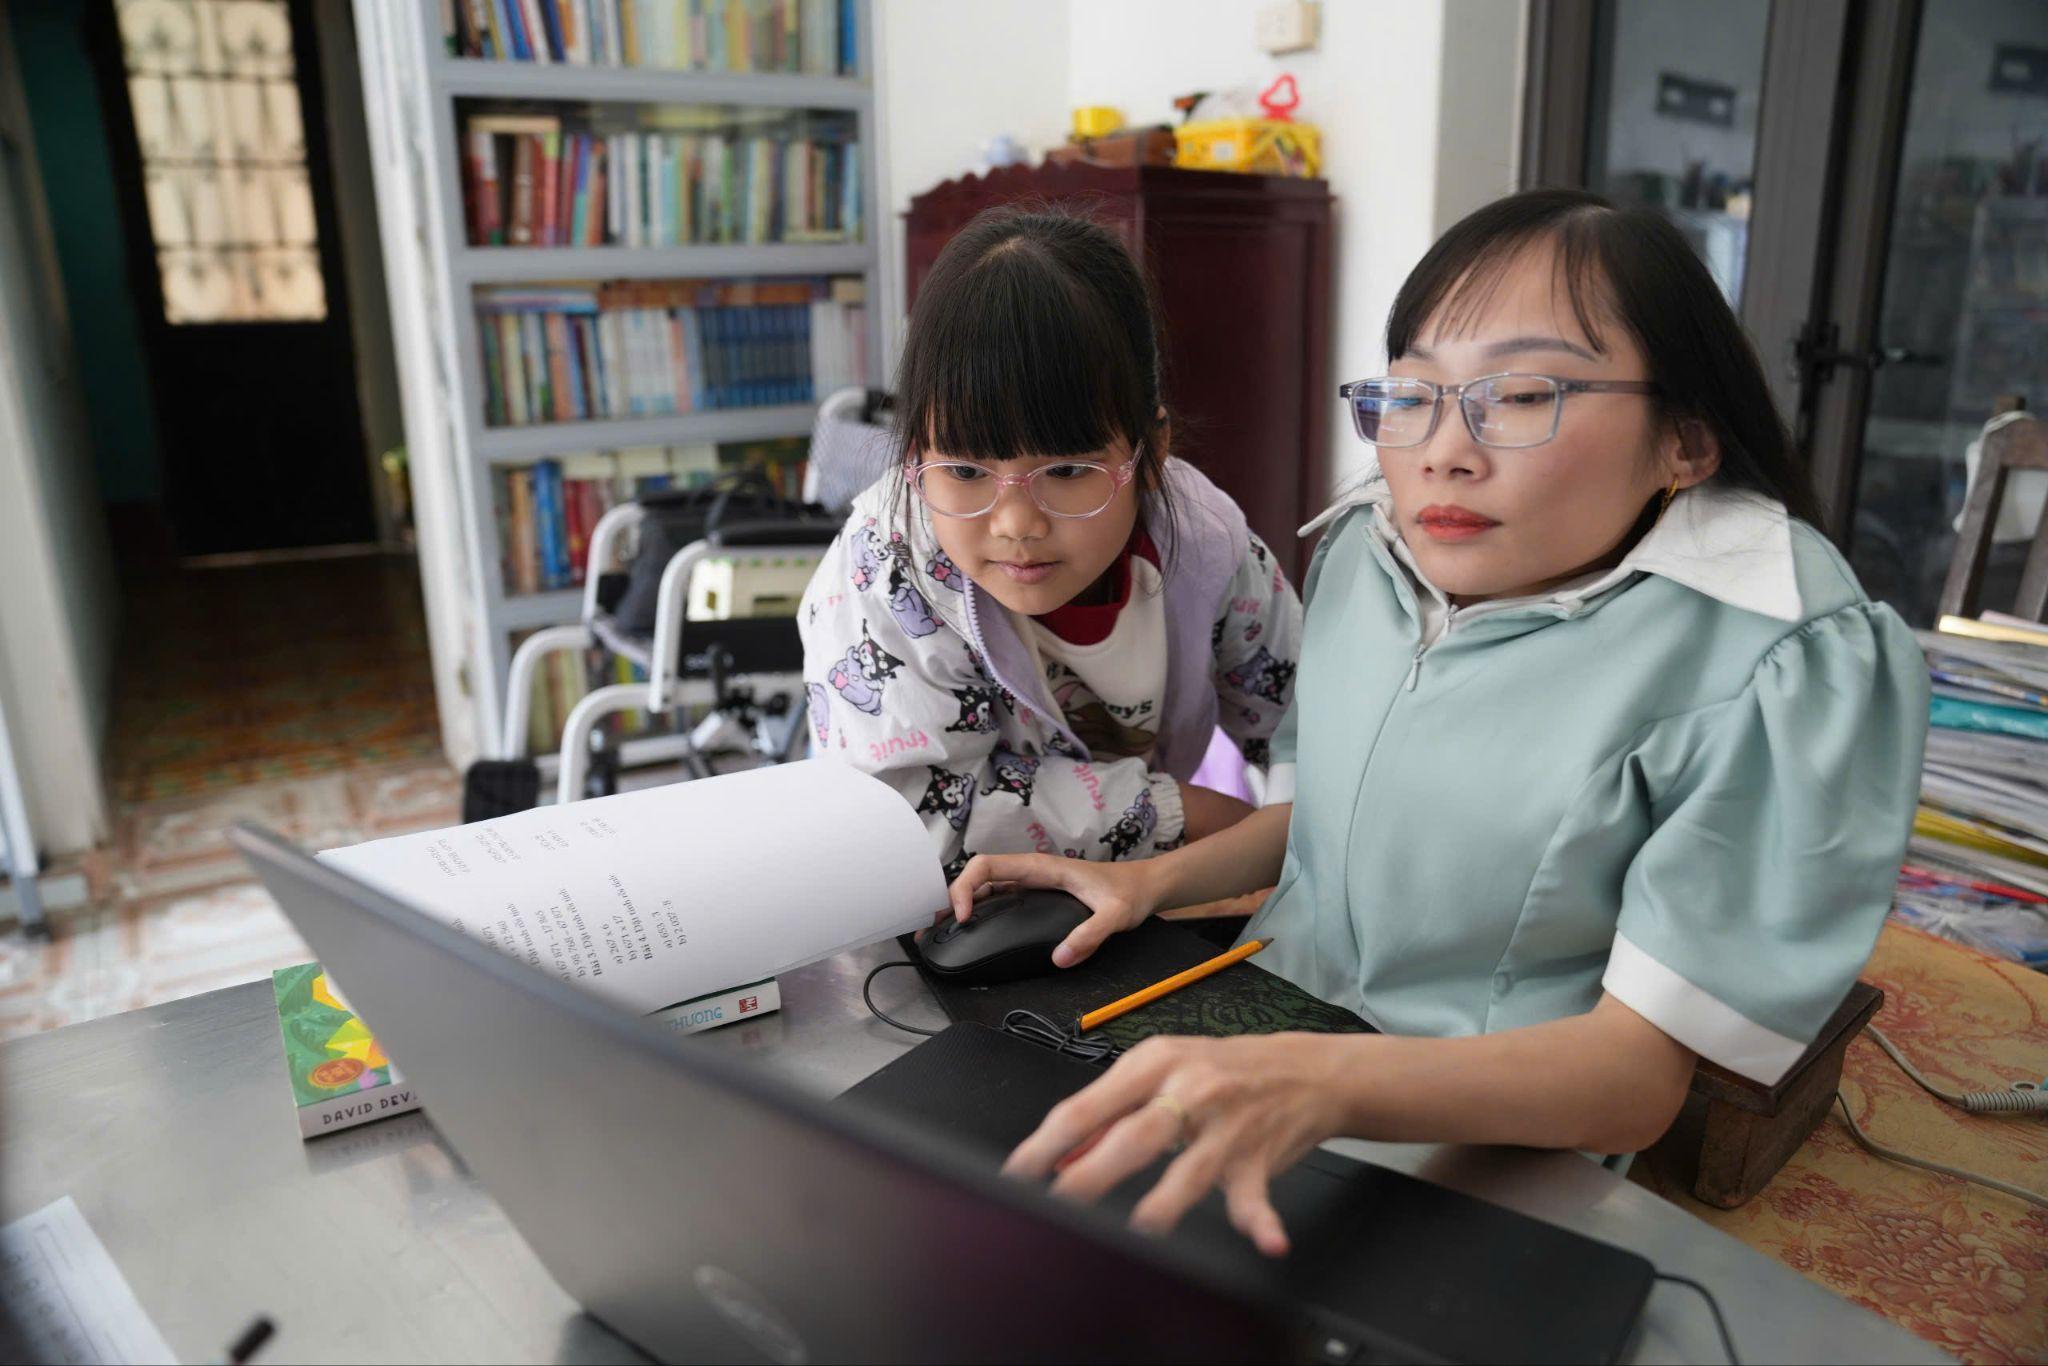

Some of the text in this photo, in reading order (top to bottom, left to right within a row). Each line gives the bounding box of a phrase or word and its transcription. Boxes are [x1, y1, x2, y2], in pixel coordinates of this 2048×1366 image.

[870, 730, 928, 761] fruit
[322, 1092, 417, 1125] DAVID DEV
